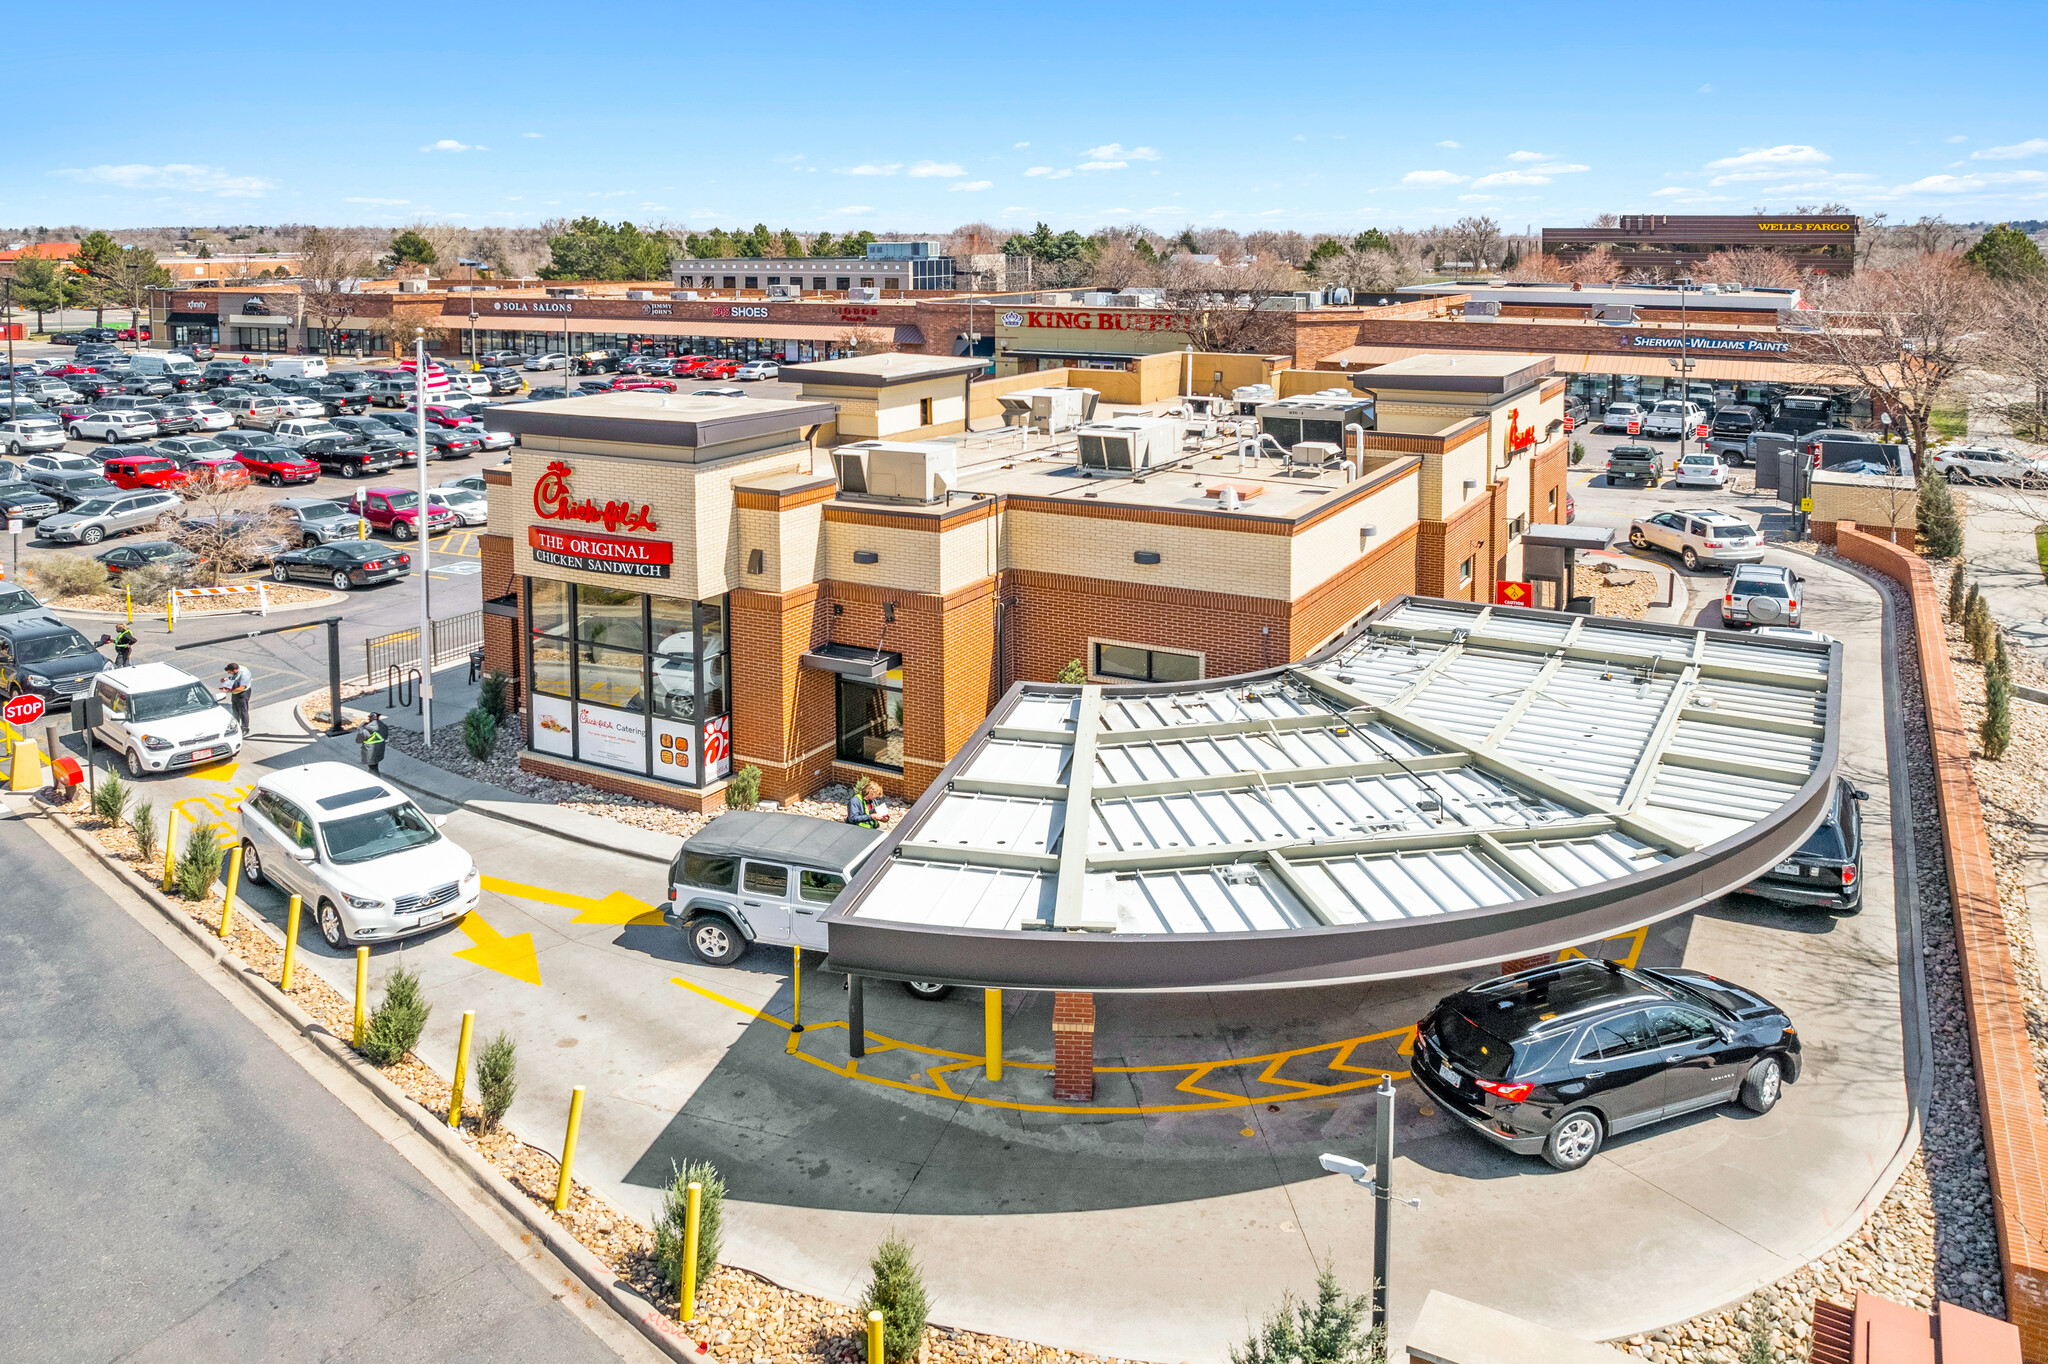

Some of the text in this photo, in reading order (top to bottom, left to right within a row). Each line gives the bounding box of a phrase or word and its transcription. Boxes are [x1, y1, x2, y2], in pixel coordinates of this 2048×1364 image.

[503, 302, 572, 312] SOLA SALONS
[712, 306, 768, 317] SAS SHOES
[1028, 311, 1091, 330] KING
[1748, 340, 1789, 352] PAINTS
[533, 466, 658, 533] Chick-fil-A
[538, 533, 650, 559] THE ORIGINAL
[536, 549, 662, 577] CHICKEN SANDWICH
[6, 701, 42, 718] STOP
[616, 723, 647, 737] Catering
